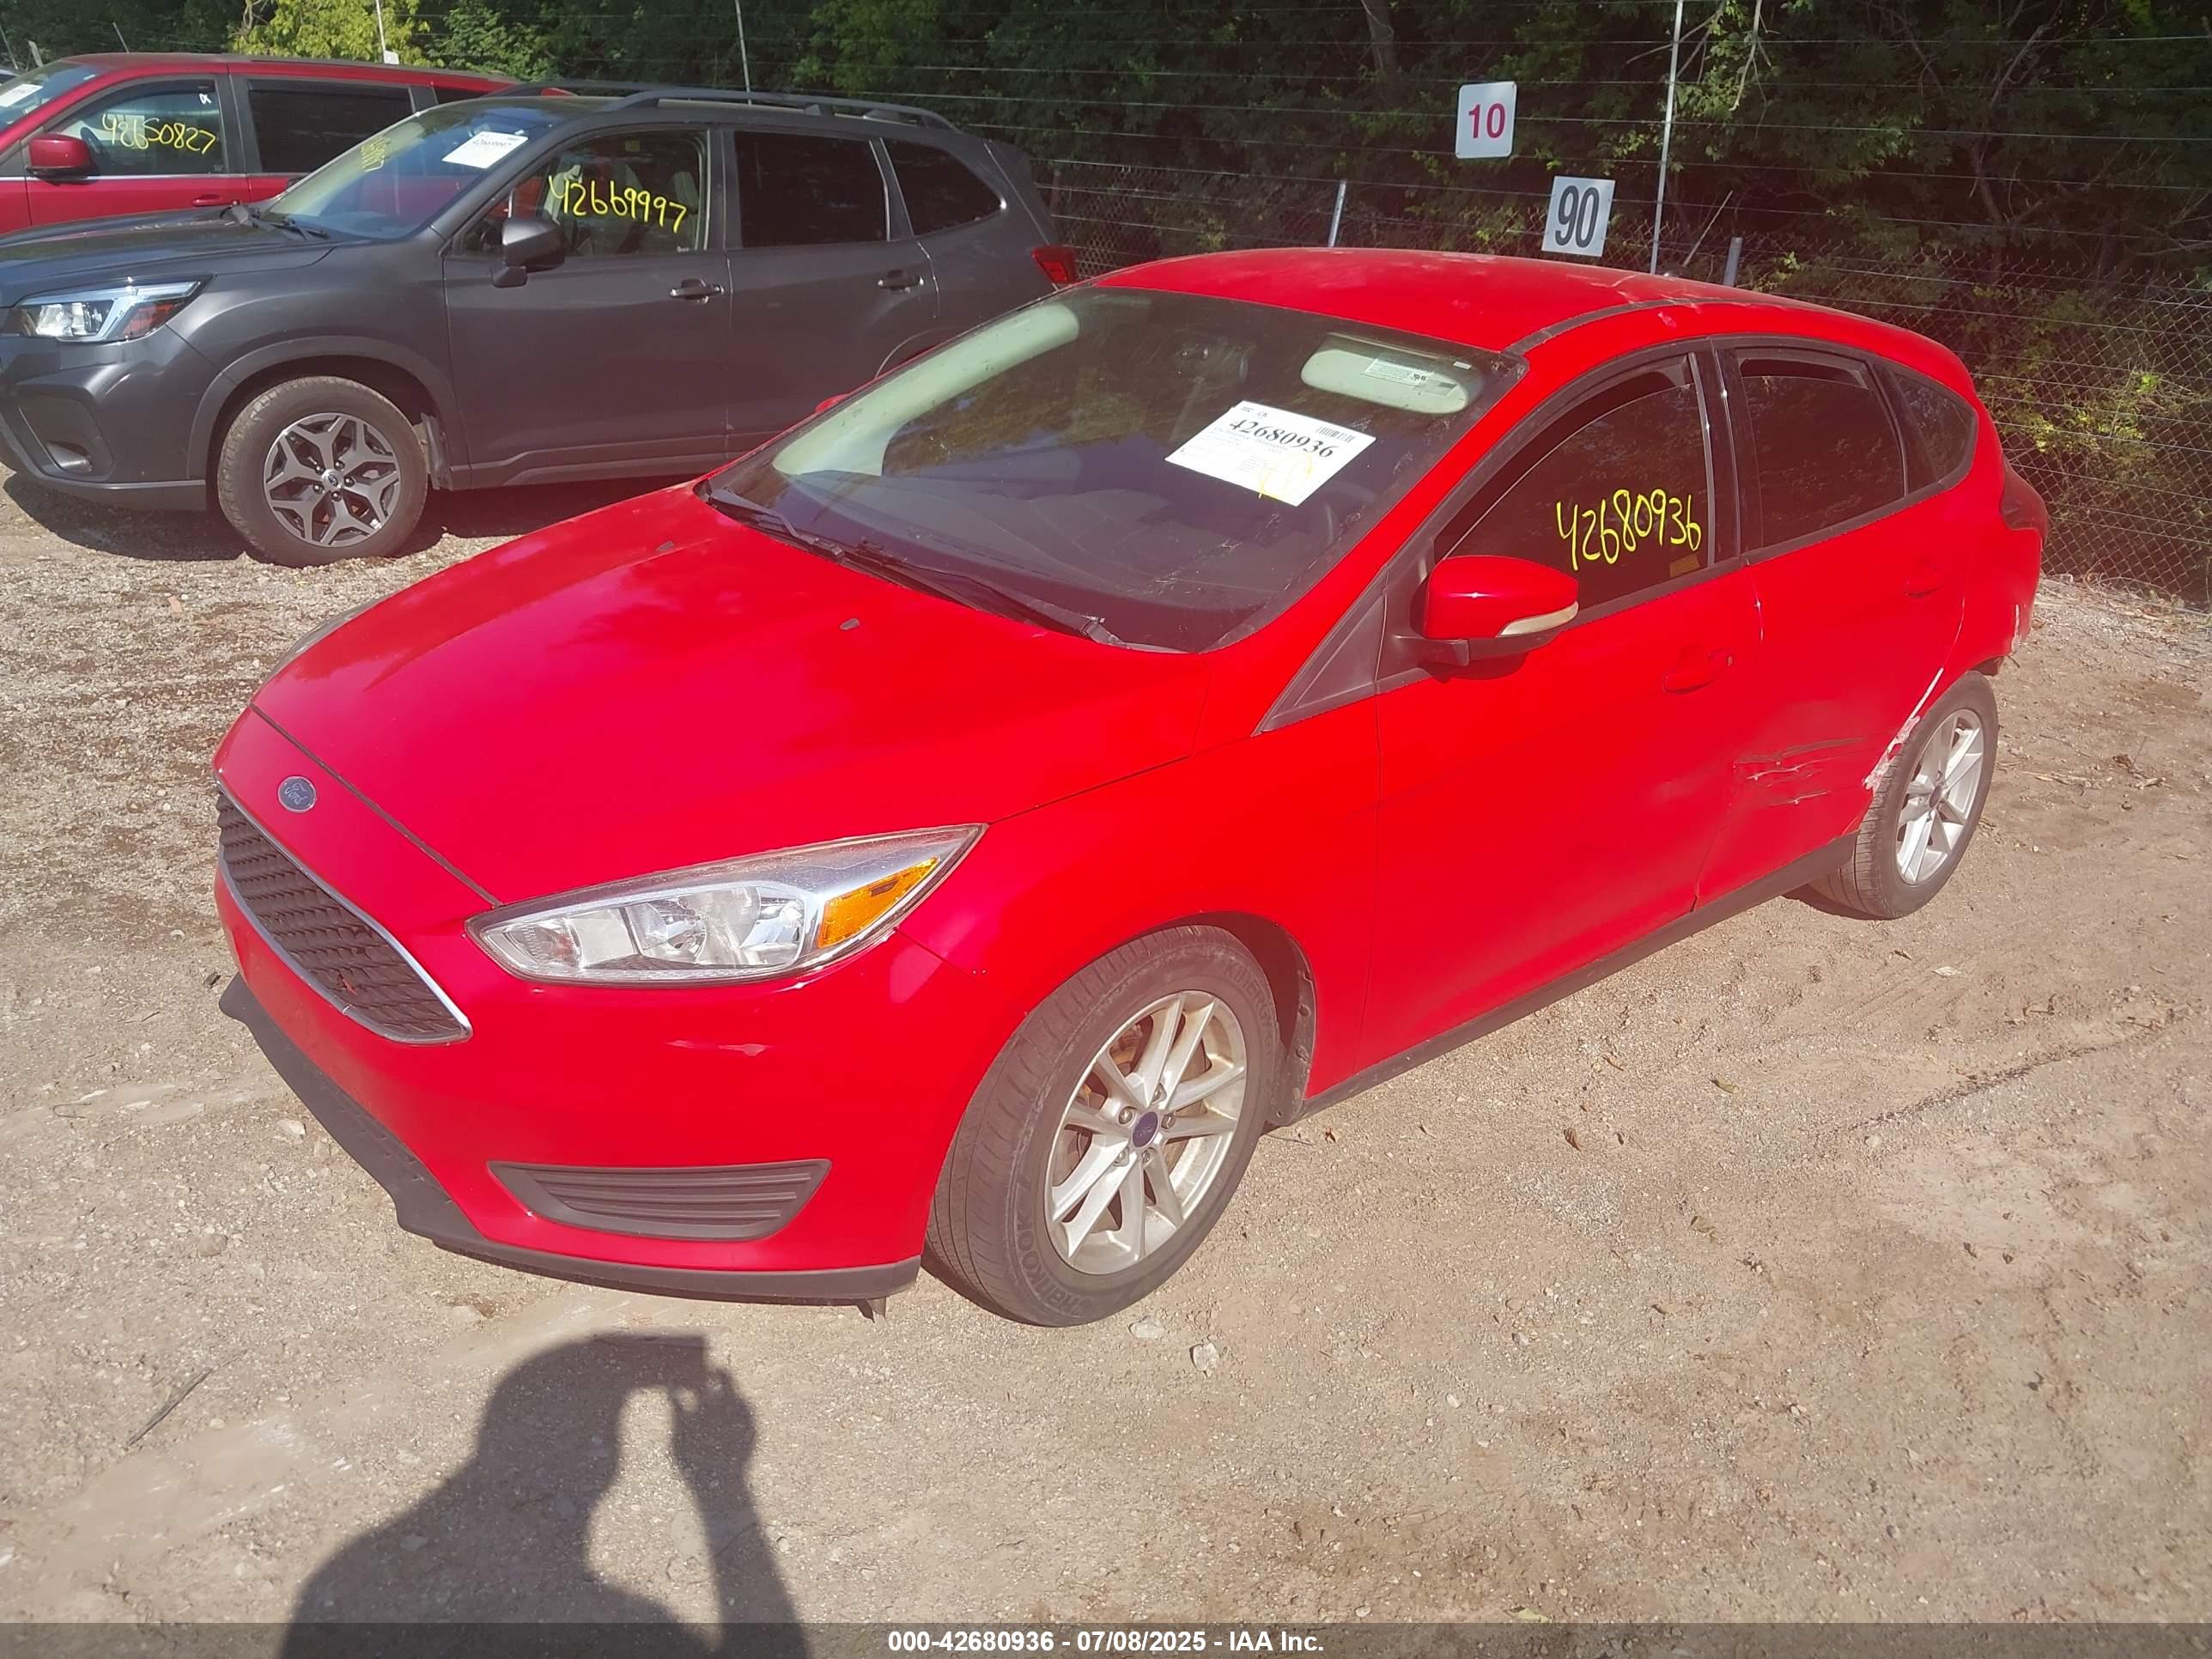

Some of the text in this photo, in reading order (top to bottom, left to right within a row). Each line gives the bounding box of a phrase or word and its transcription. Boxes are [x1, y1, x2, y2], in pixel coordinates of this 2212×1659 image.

[102, 112, 216, 155] 42650827
[1468, 102, 1506, 139] 10
[548, 174, 688, 234] 42669997
[1555, 185, 1600, 248] 90
[1229, 419, 1340, 458] 42680936
[1556, 489, 1703, 571] 42680936
